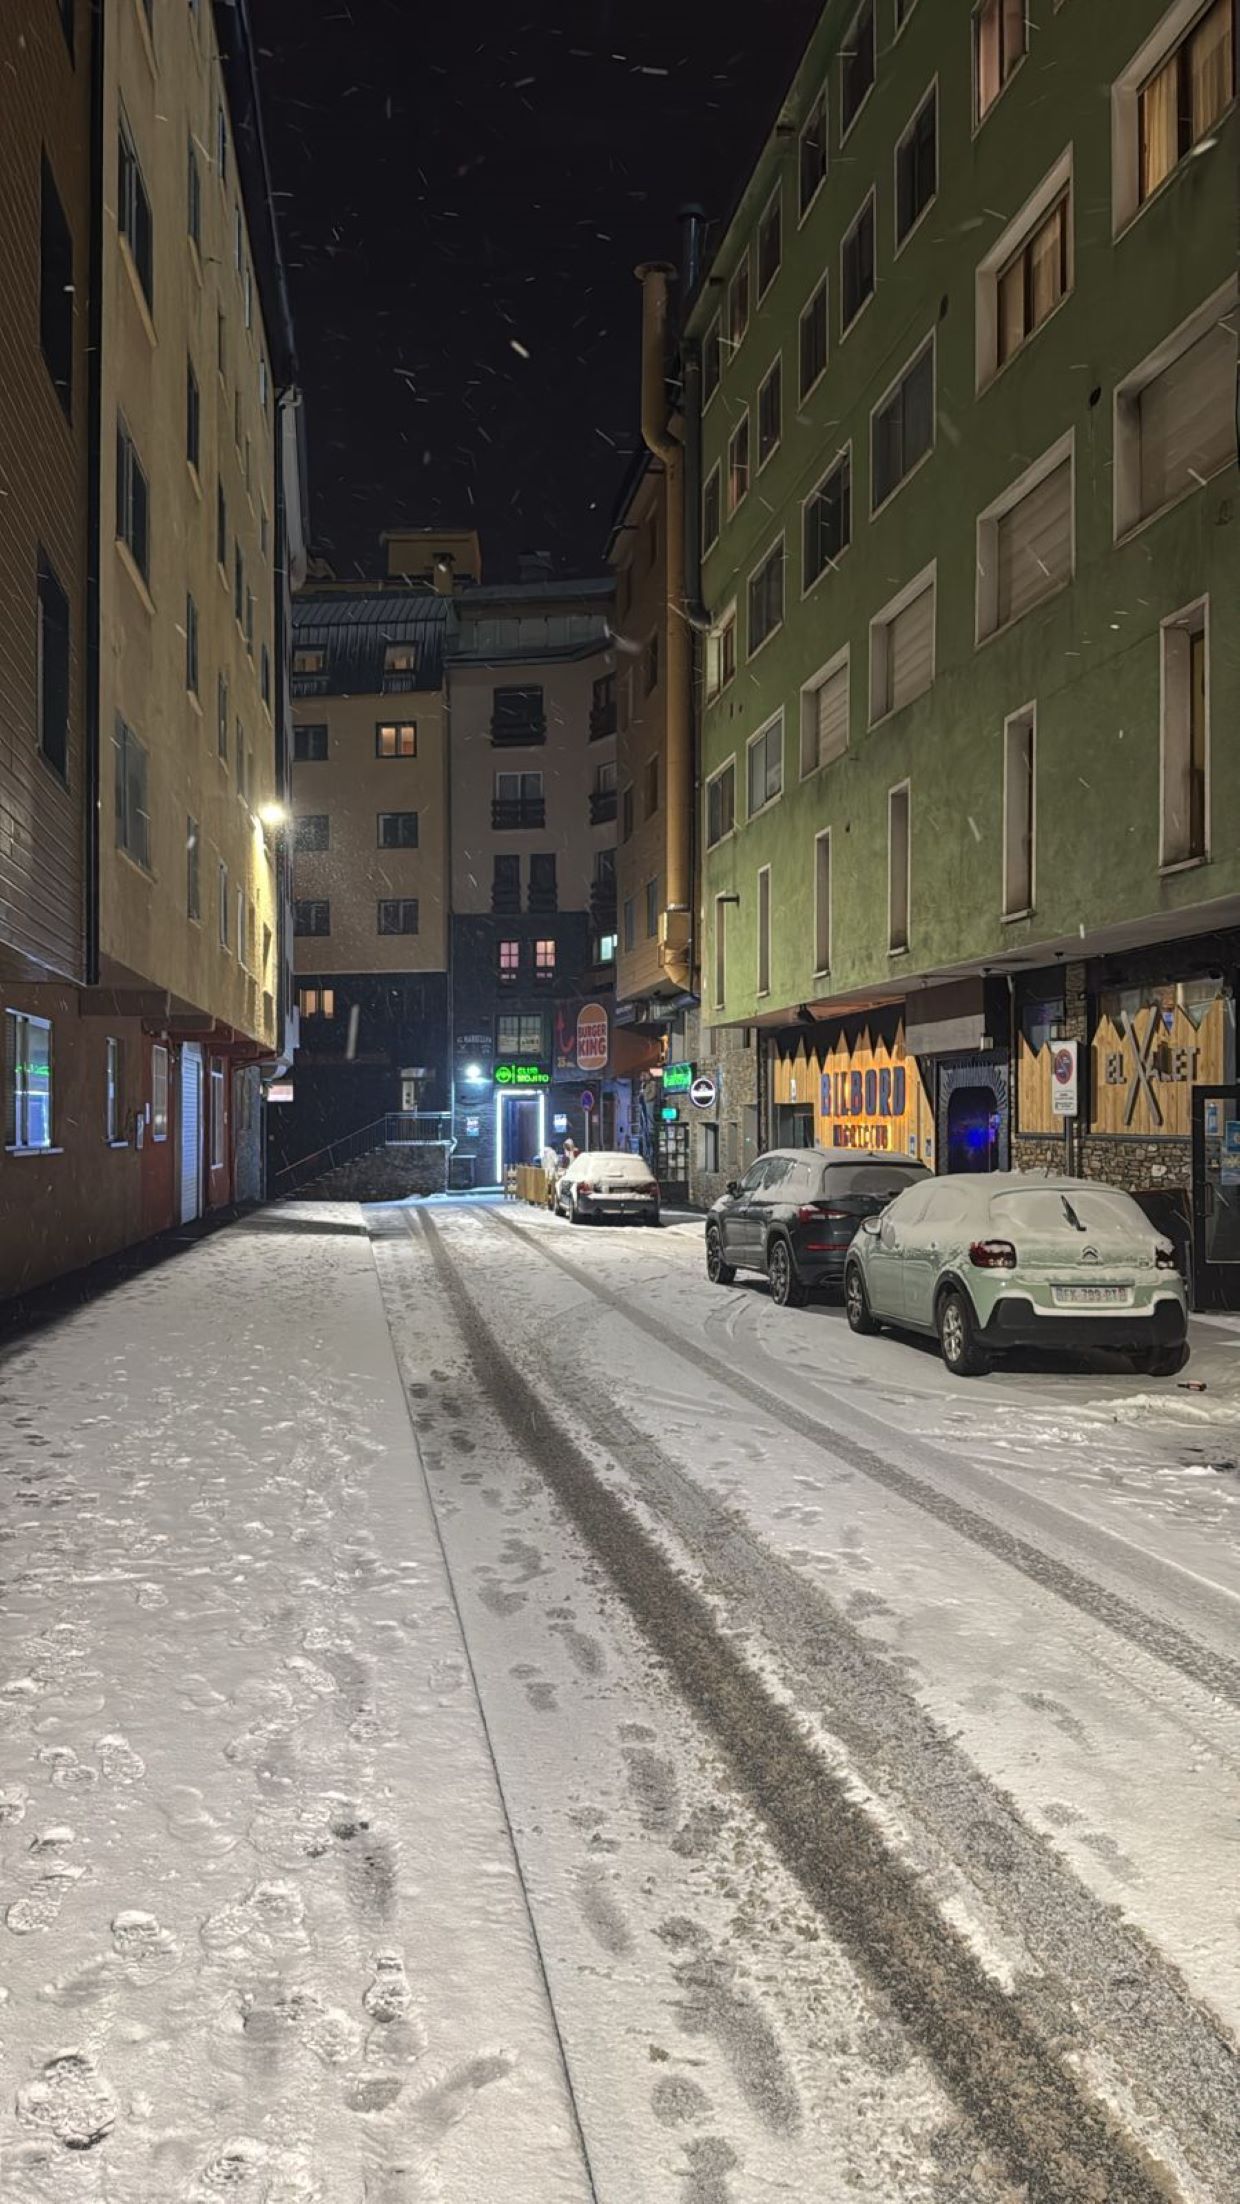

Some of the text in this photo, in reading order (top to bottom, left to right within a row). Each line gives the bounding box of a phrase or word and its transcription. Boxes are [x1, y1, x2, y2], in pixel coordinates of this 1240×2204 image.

[577, 1023, 607, 1038] BURGER
[577, 1037, 607, 1057] KING
[517, 1066, 538, 1075] CLUB
[1104, 1051, 1128, 1085] EL
[517, 1074, 549, 1083] MOJITO
[820, 1065, 906, 1118] BILBORD
